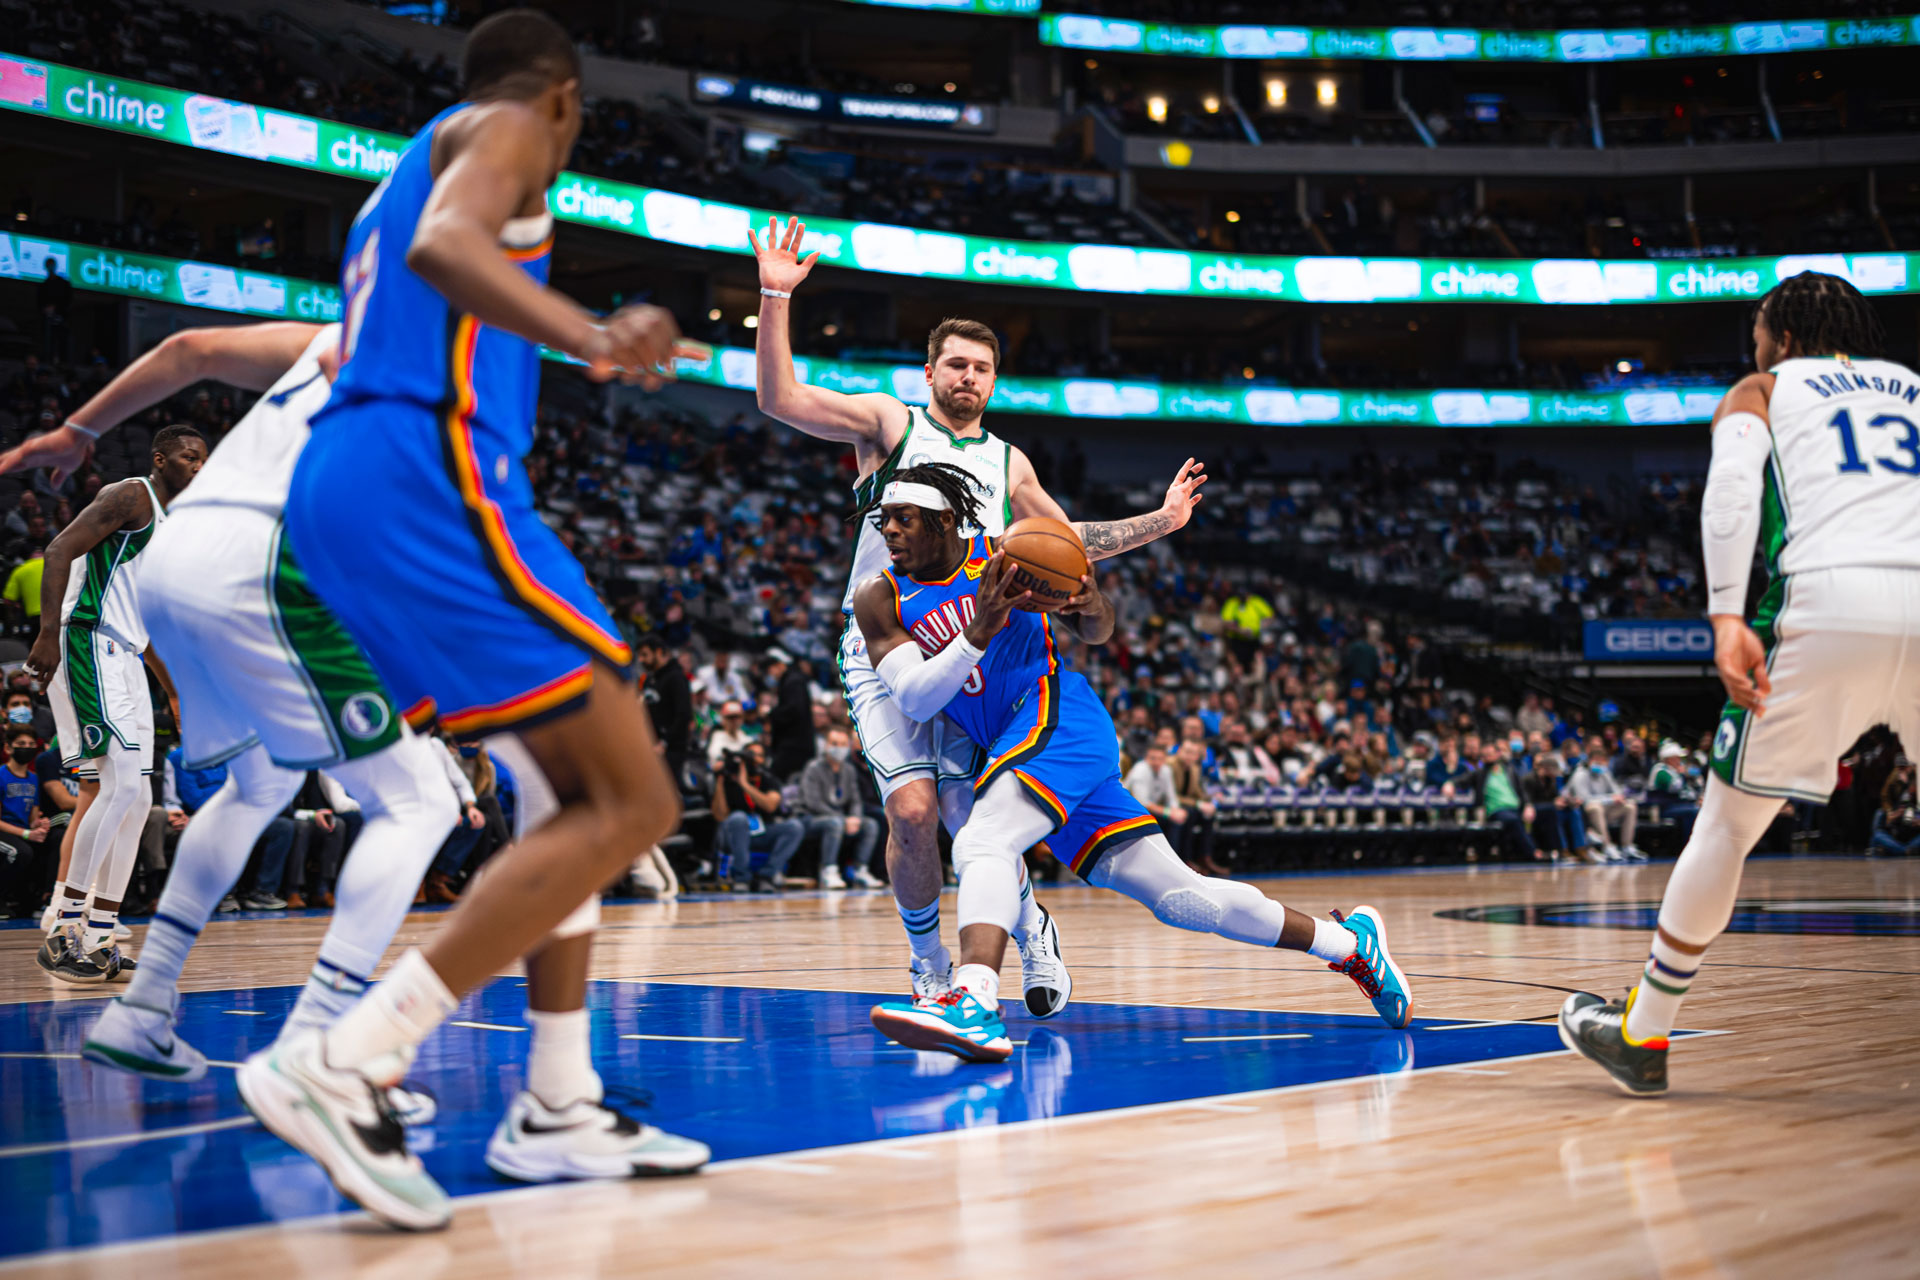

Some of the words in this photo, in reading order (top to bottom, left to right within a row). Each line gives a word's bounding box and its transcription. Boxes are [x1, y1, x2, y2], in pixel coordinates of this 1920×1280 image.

[65, 79, 166, 131] chime
[330, 133, 399, 173] chim
[556, 182, 635, 226] chime
[80, 252, 164, 295] chime
[973, 245, 1059, 281] chime
[1199, 259, 1285, 293] chime
[1431, 264, 1519, 297] chime
[1668, 264, 1760, 297] chime
[295, 286, 342, 319] chi
[1804, 372, 1920, 404] BRUNSON
[1827, 407, 1920, 478] 13
[1014, 567, 1072, 600] Wilson
[909, 594, 978, 658] HUND
[1605, 627, 1712, 652] GEICO
